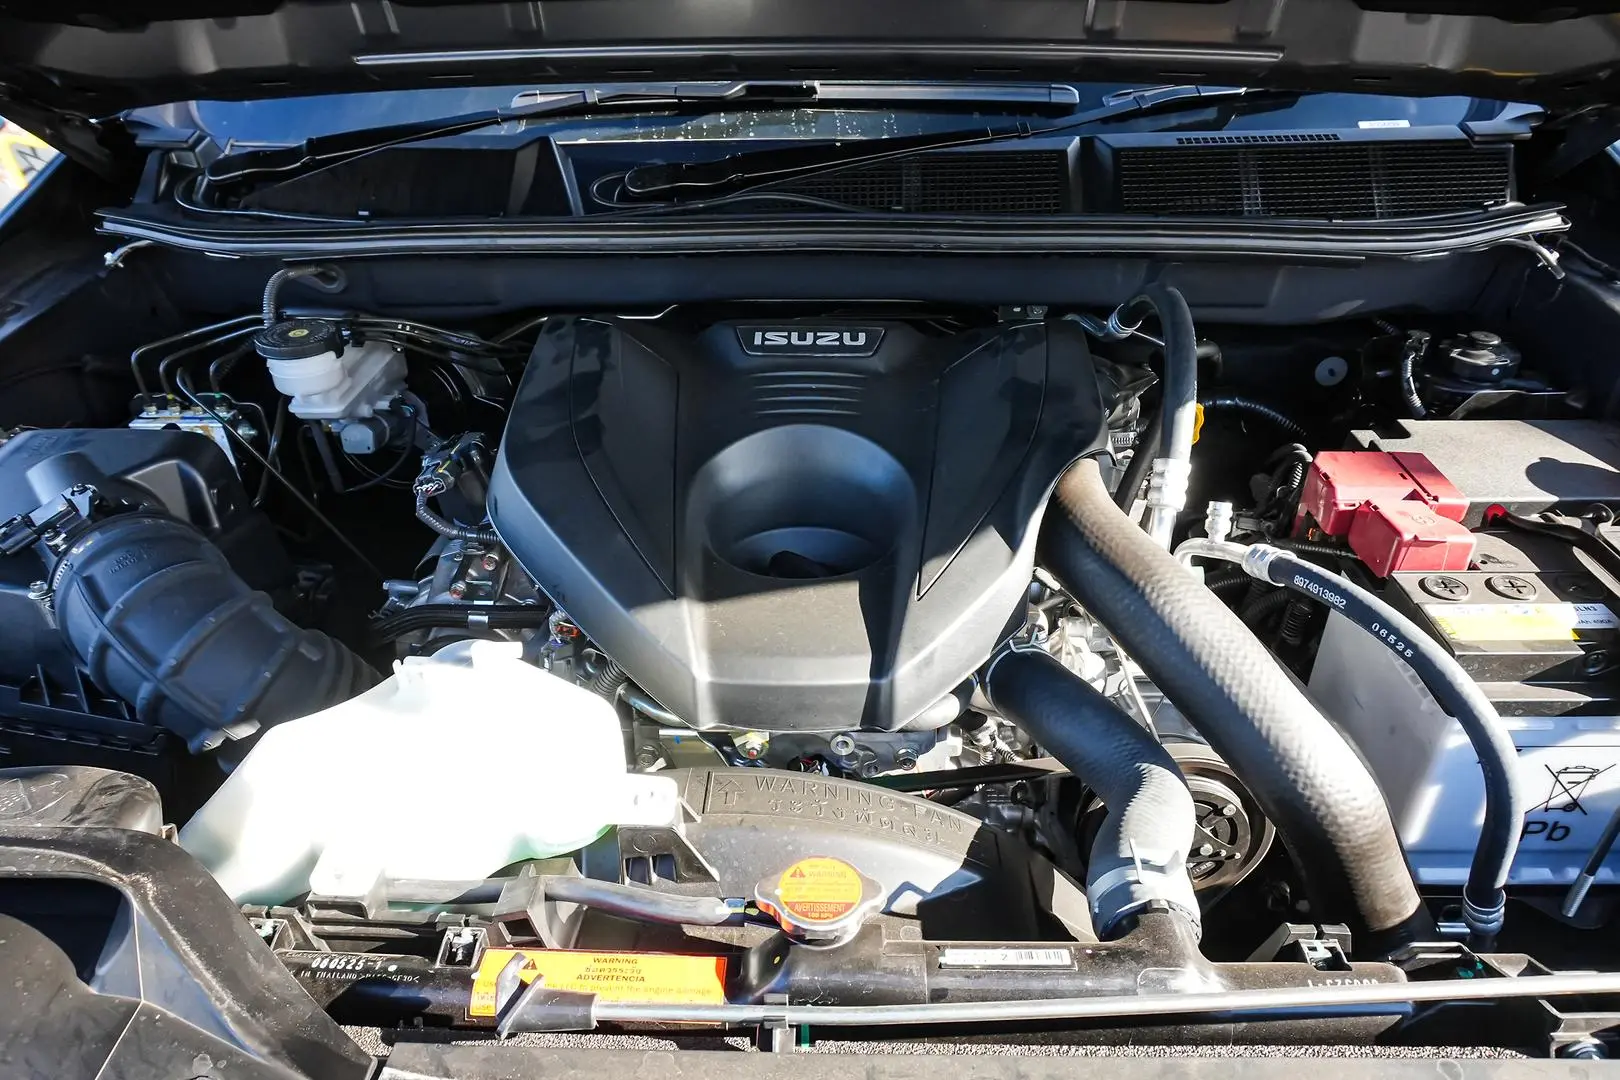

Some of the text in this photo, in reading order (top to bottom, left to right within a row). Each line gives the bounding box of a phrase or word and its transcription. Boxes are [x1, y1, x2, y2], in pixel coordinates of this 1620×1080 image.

[754, 331, 866, 346] ISUZU
[1293, 575, 1414, 658] 8974913982 06525
[1520, 821, 1571, 841] Pb
[794, 903, 846, 913] AVERTISSEMENT
[593, 957, 638, 965] WARNING
[576, 974, 646, 983] ADVERTENCIA
